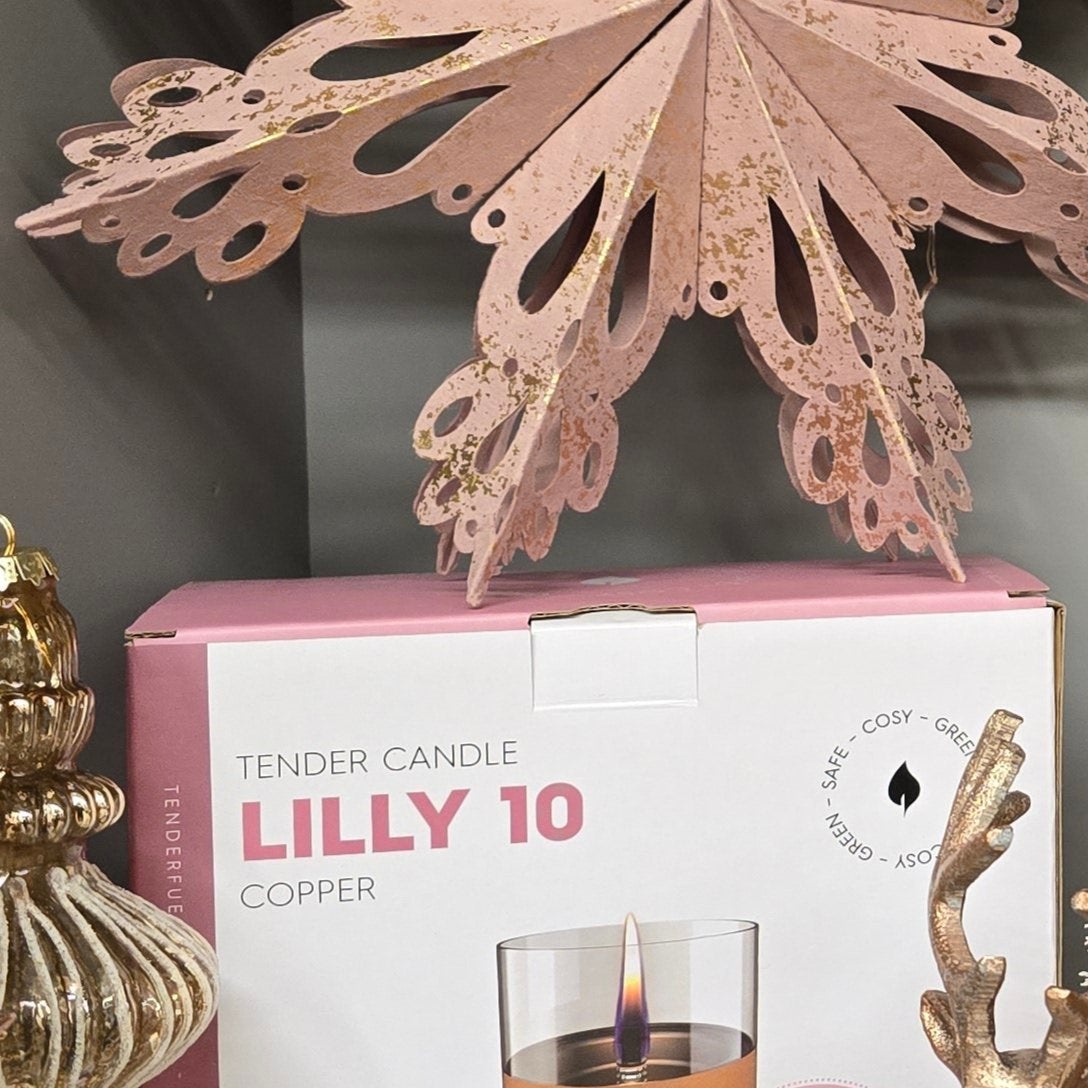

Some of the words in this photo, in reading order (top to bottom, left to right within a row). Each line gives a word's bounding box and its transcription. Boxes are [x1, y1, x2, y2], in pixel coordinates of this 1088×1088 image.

[861, 709, 914, 735] COSY
[236, 748, 368, 780] TENDER
[383, 740, 518, 773] CANDLE
[821, 745, 850, 791] SAFE
[242, 789, 470, 861] LILLY
[500, 782, 584, 844] 10
[825, 812, 874, 861] GREEN
[163, 784, 184, 914] TENDERFUE
[240, 876, 376, 910] COPPER
